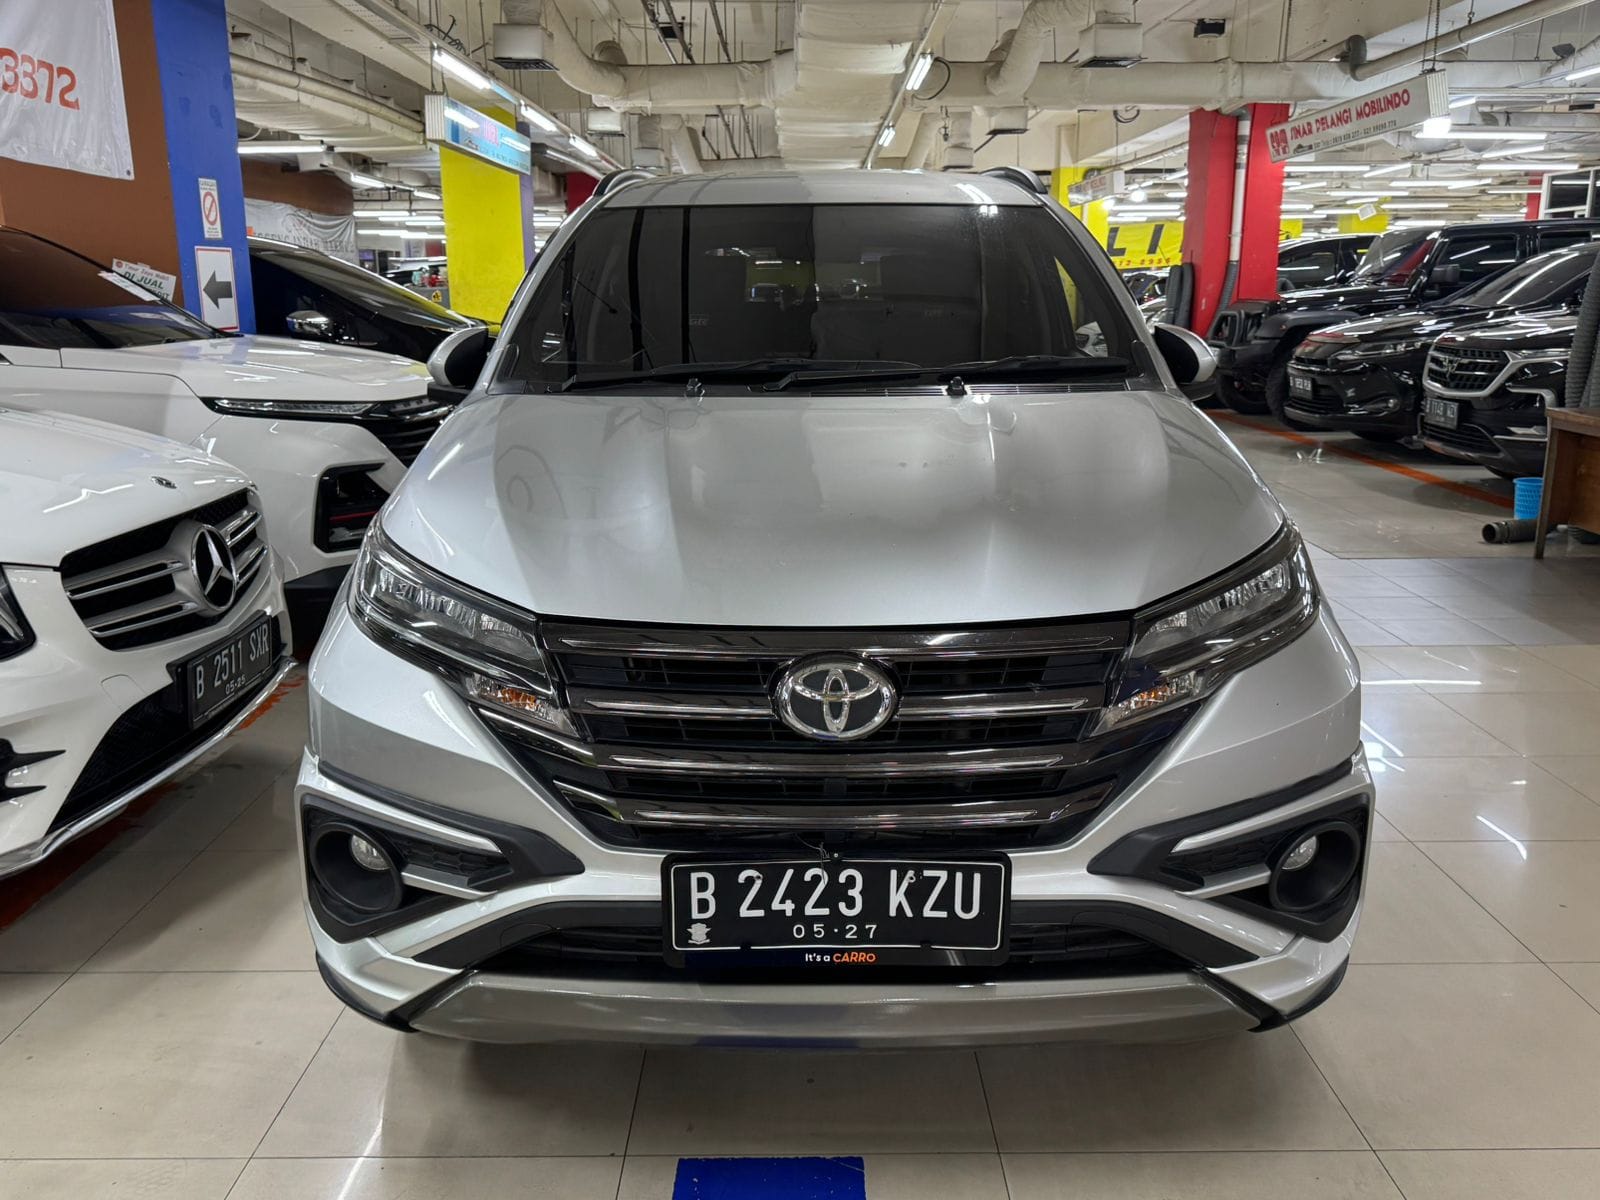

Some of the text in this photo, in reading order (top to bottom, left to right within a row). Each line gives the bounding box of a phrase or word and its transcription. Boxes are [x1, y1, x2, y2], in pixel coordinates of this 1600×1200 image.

[0, 47, 80, 111] 3372
[1290, 122, 1313, 141] SINAR
[1316, 108, 1352, 133] PELANGI
[1355, 89, 1410, 121] MOBILINDO
[138, 276, 164, 290] JUAL
[196, 623, 269, 699] B 2511 SXR
[689, 867, 981, 920] B 2423 KZU
[804, 952, 878, 963] It's a CARRO
